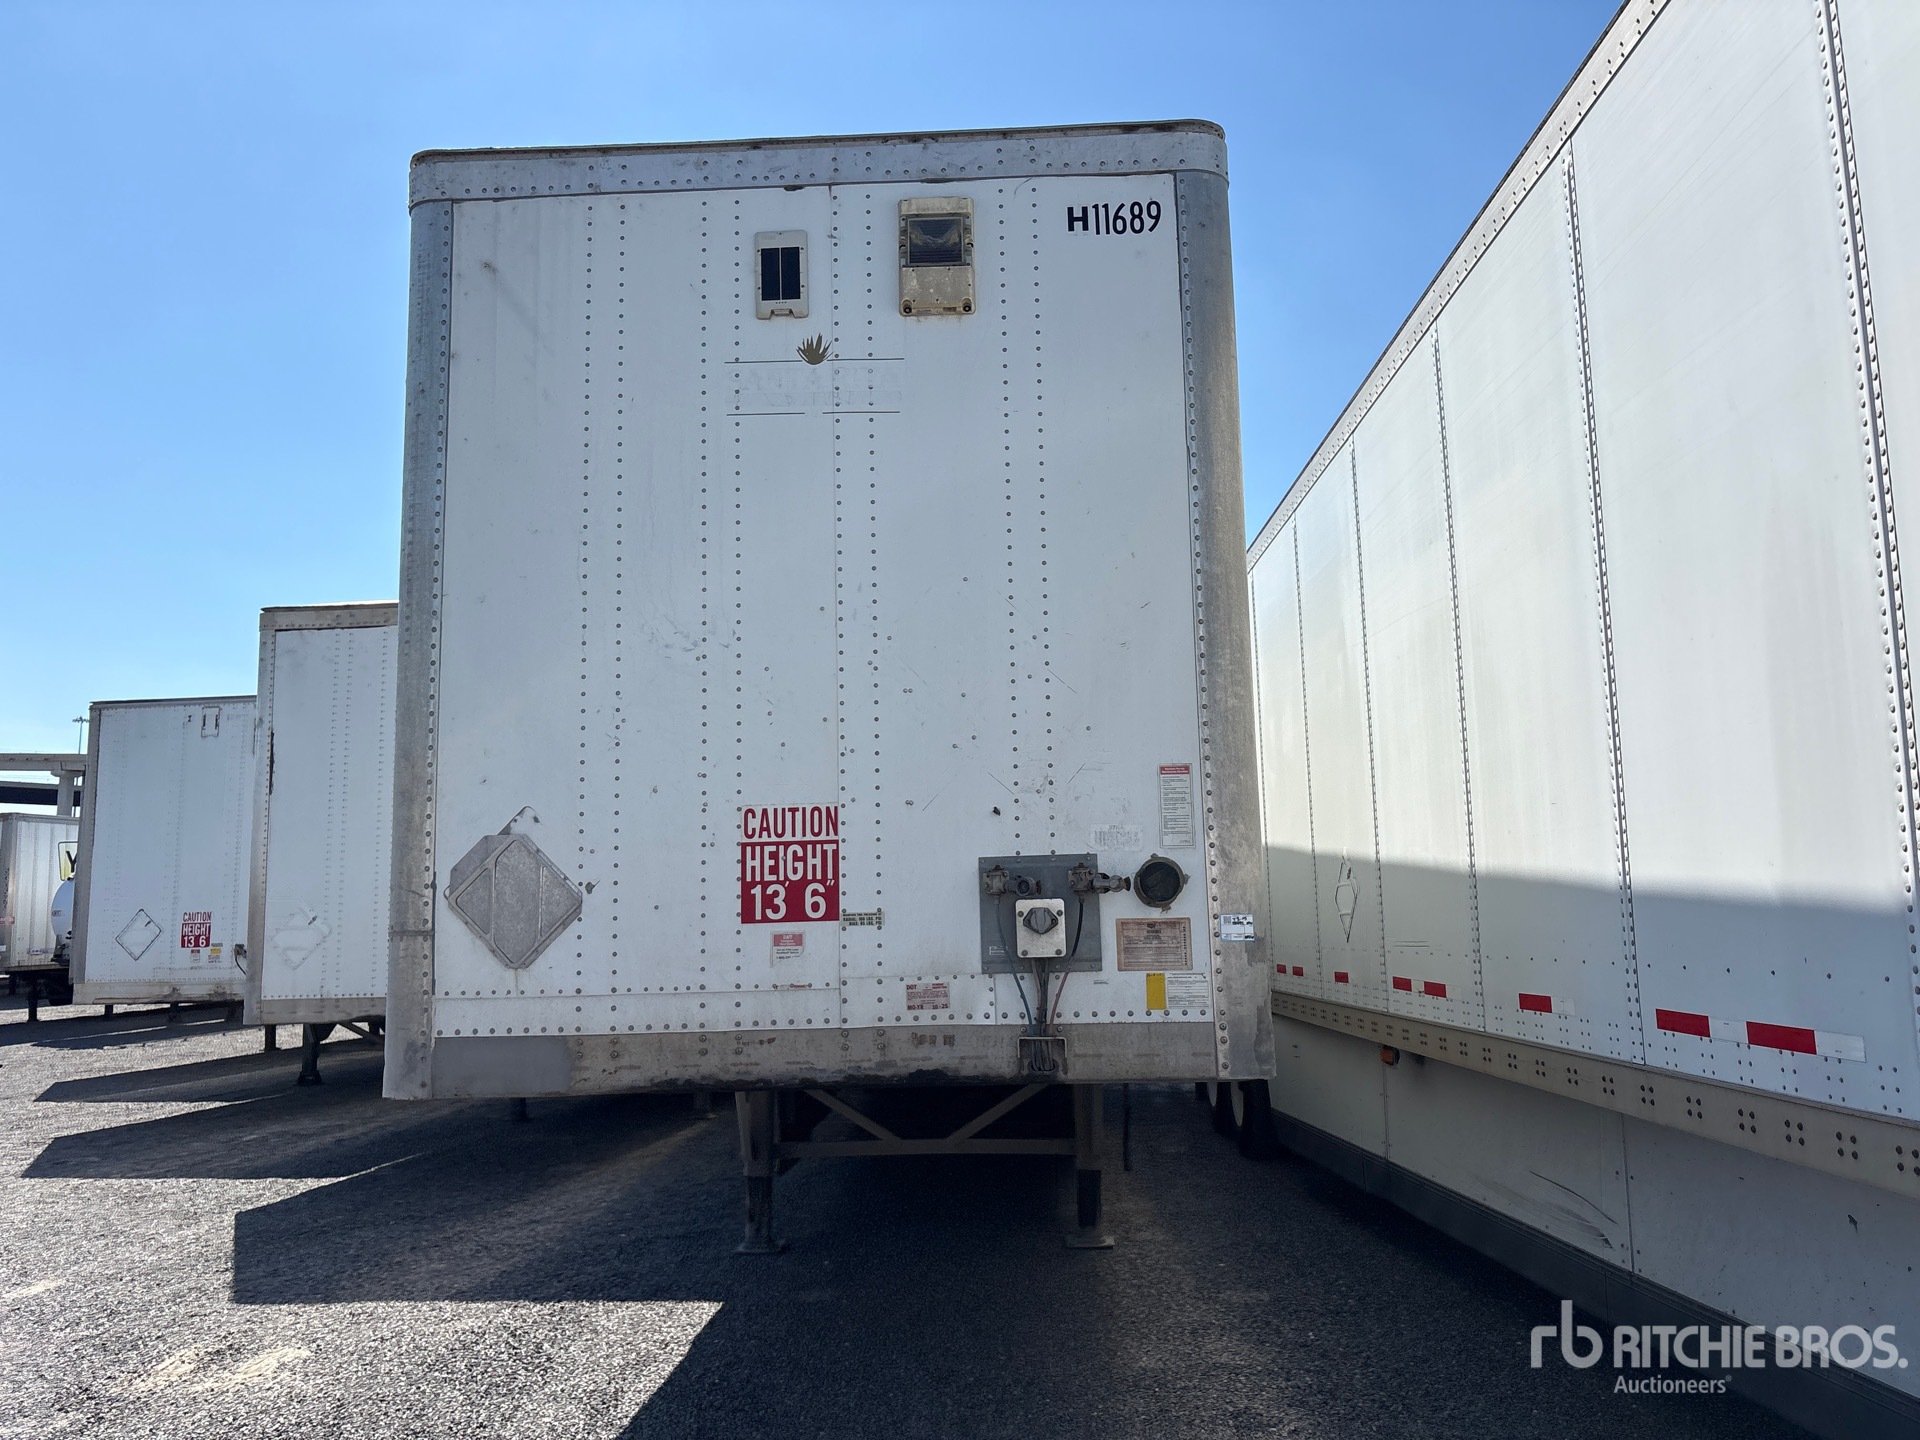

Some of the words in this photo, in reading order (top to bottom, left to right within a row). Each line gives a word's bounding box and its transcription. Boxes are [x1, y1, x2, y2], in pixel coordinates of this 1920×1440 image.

[1067, 200, 1161, 235] H11689
[743, 805, 838, 839] CAUTION
[745, 843, 837, 882] HEIGHT
[183, 911, 212, 922] CAUTION
[183, 923, 210, 936] HEIGHT
